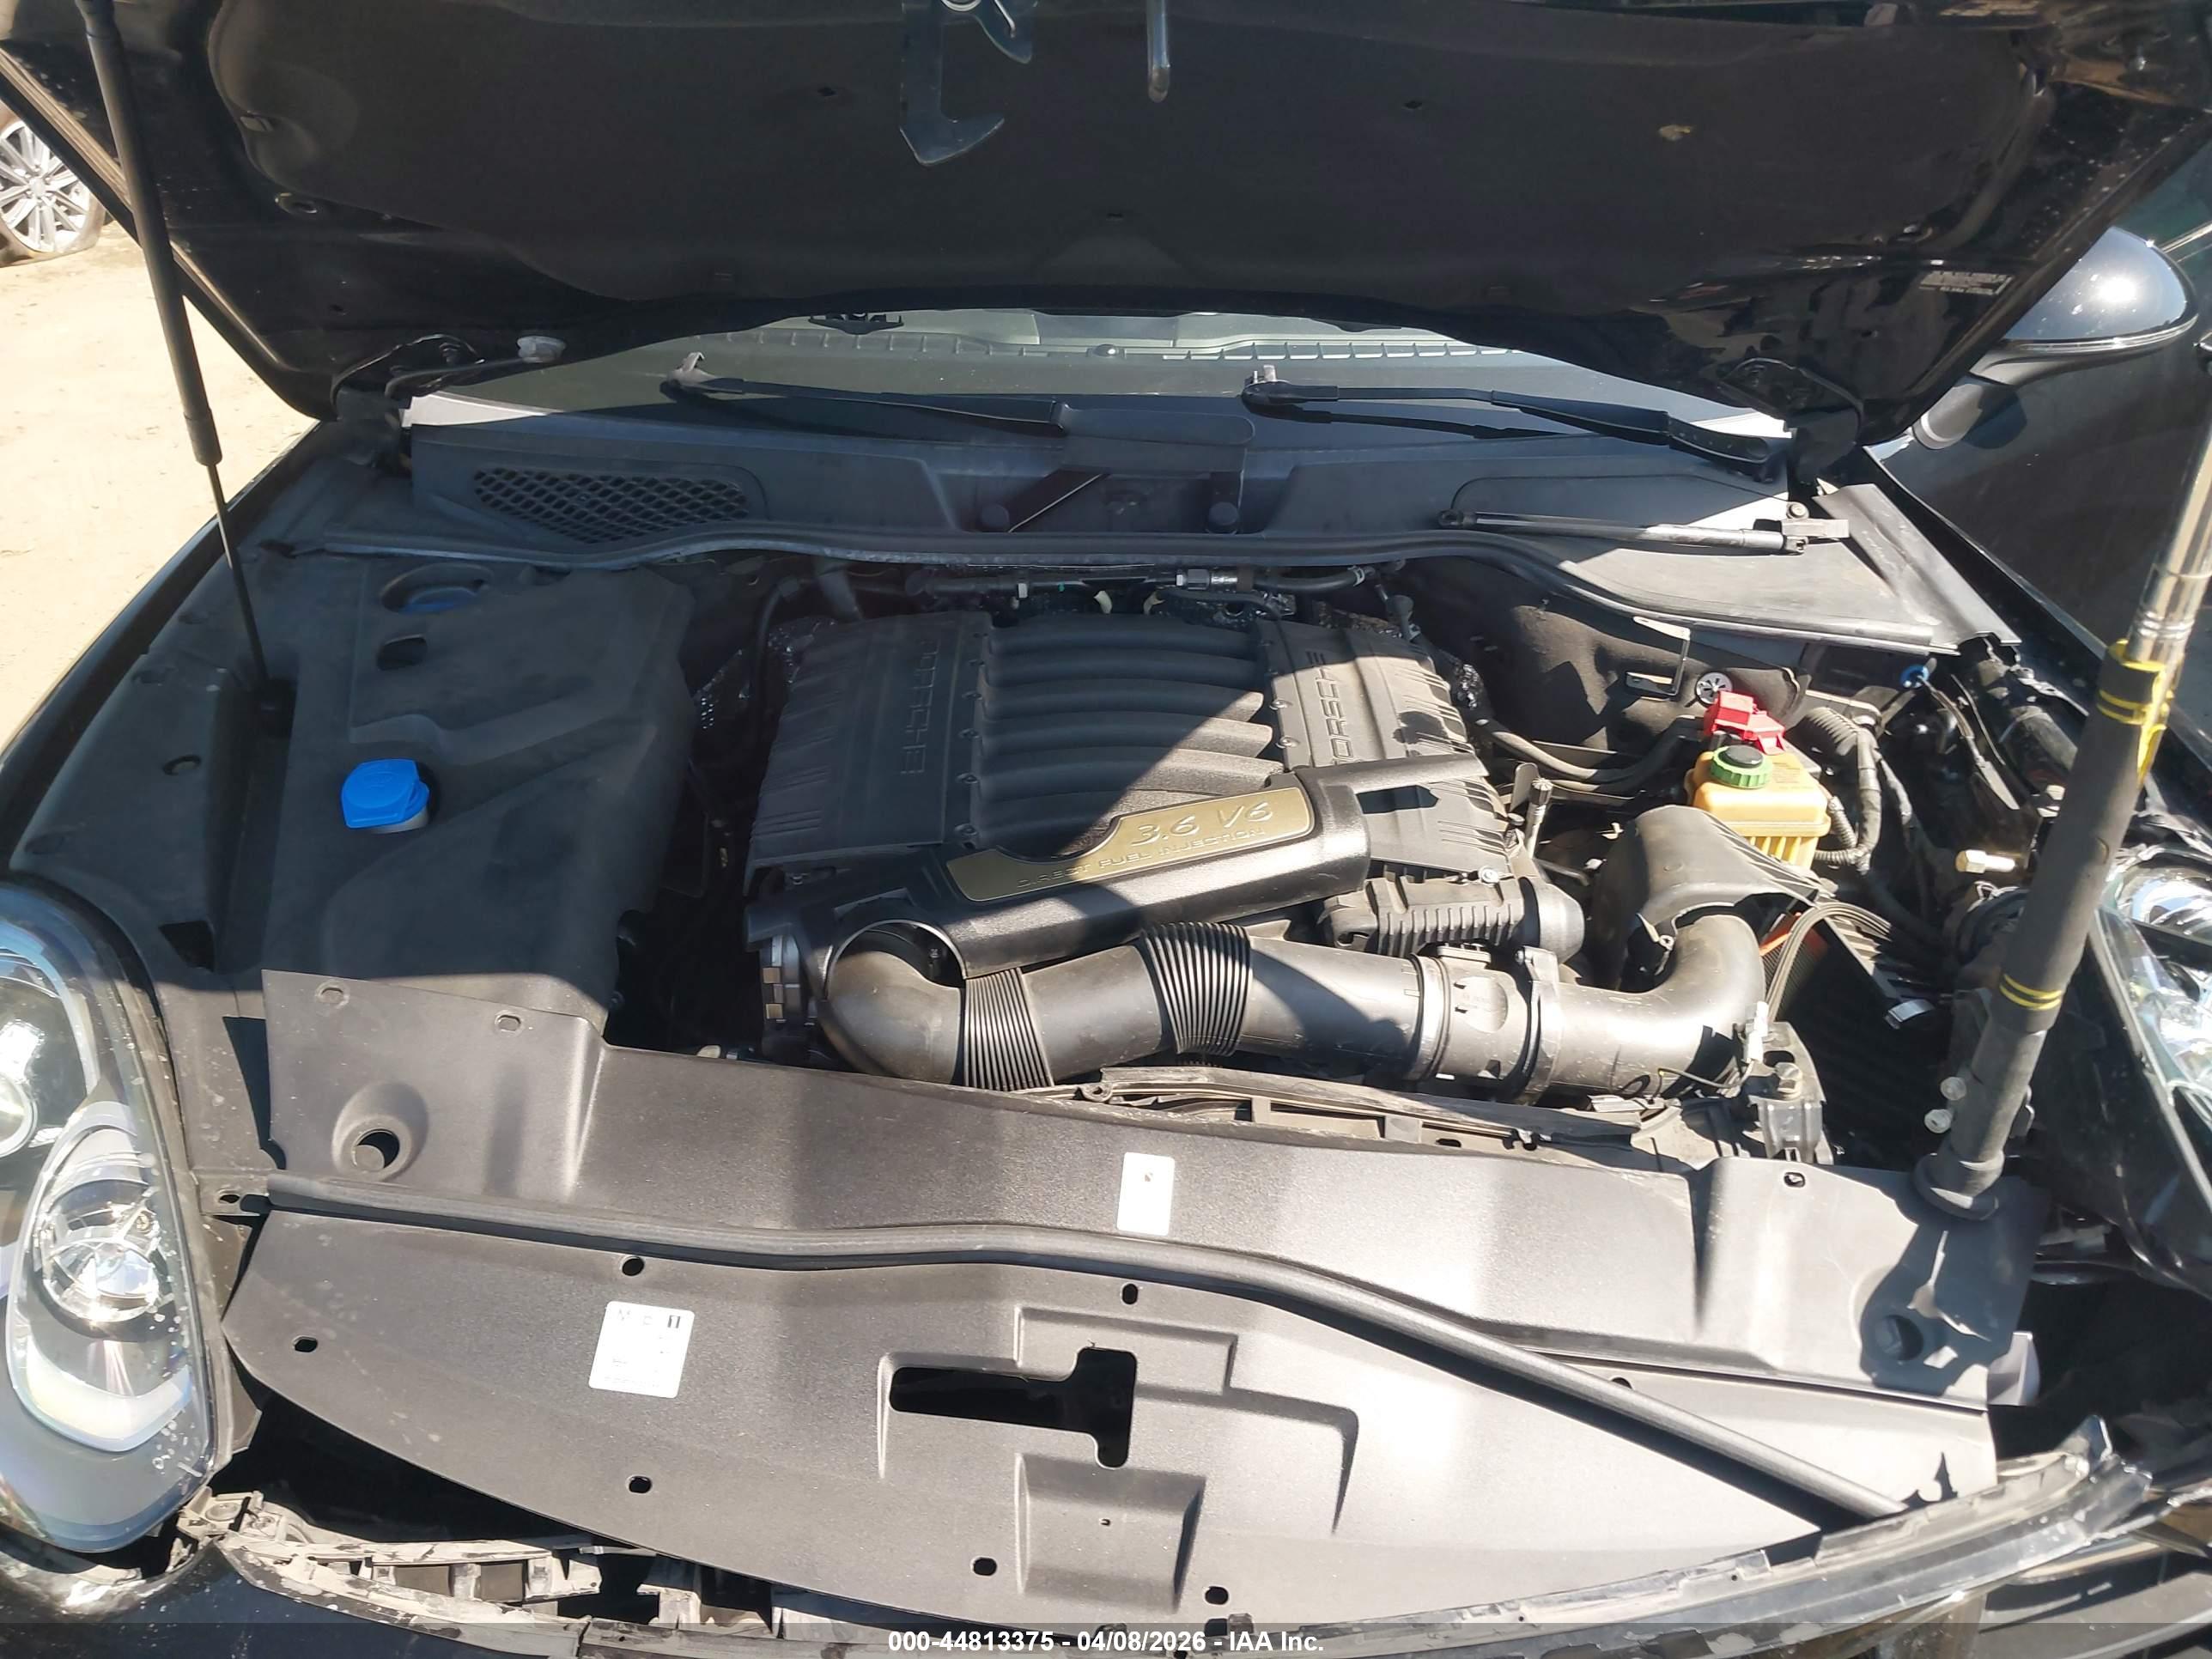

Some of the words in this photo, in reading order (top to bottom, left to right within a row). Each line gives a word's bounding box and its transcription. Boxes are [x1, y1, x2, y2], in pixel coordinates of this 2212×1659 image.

[900, 639, 941, 775] PORSCHE
[1305, 651, 1356, 766] ORSCHE
[1017, 864, 1091, 888] DIRECT
[1099, 853, 1152, 869] FUEL
[1159, 828, 1266, 856] INJECTION
[1130, 815, 1200, 847] 3.6
[1217, 801, 1273, 828] V6
